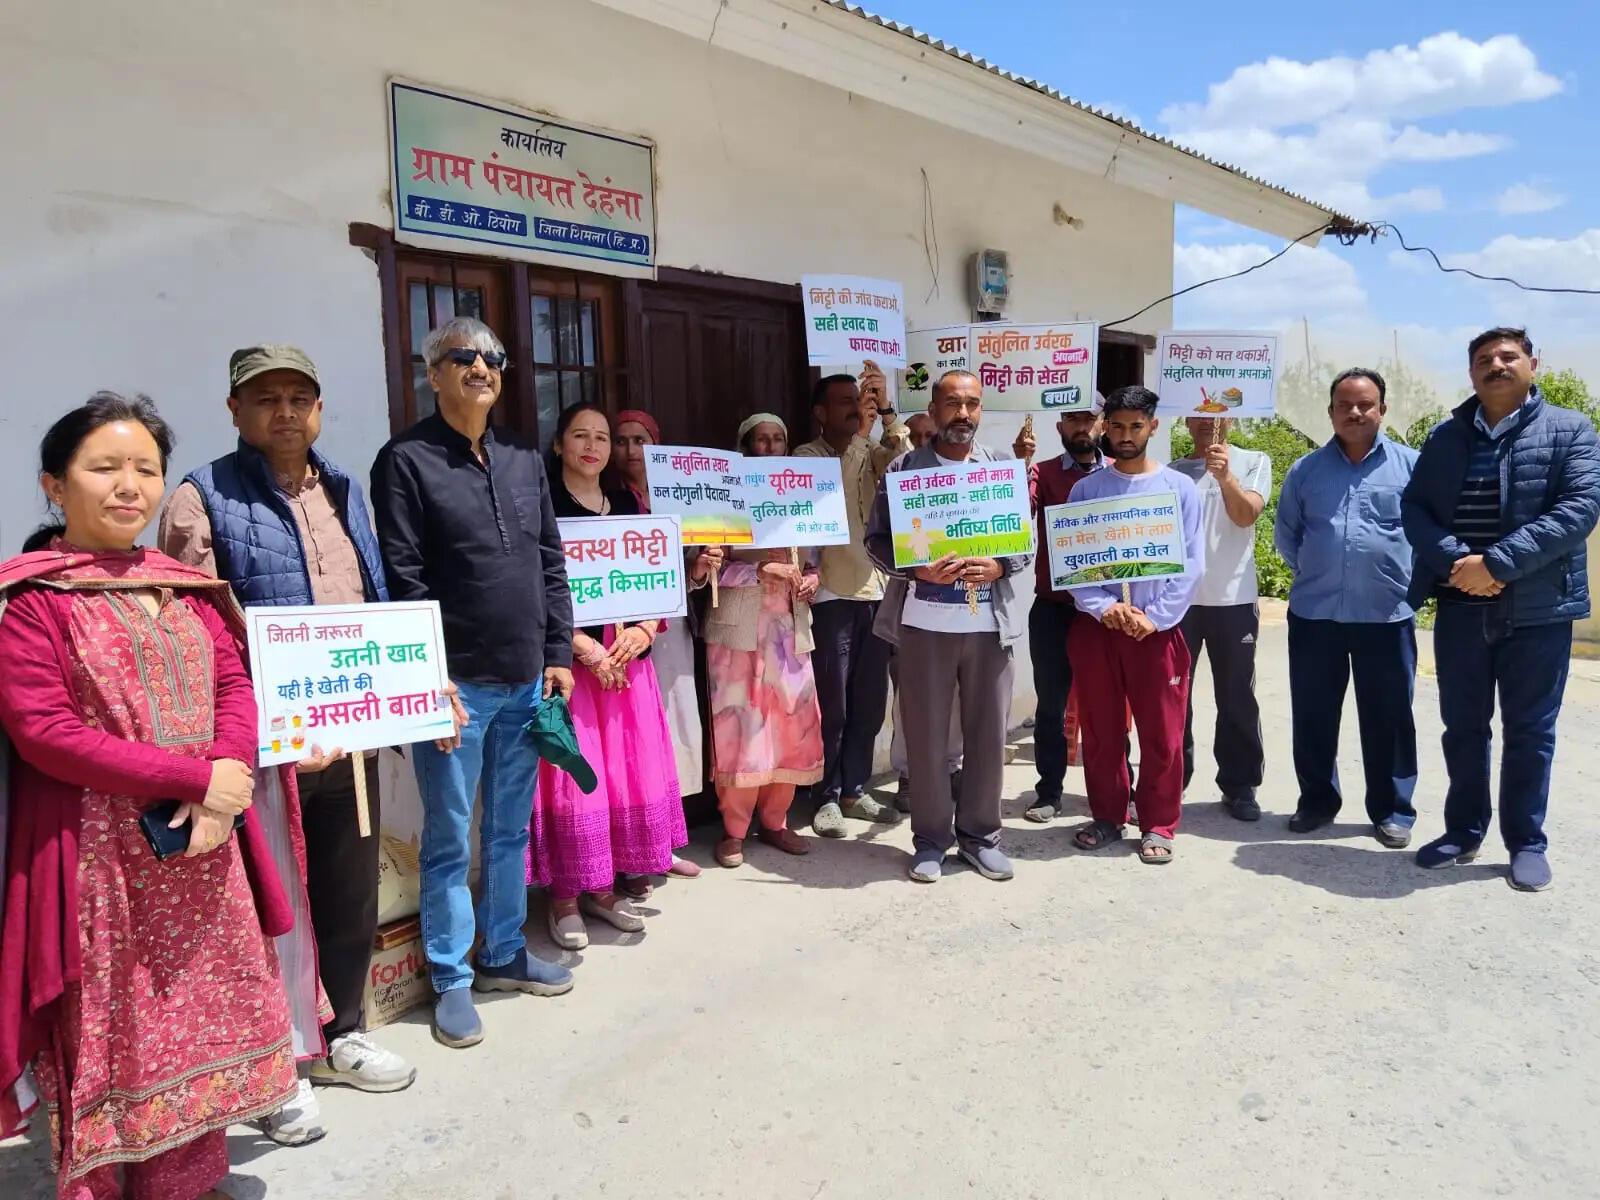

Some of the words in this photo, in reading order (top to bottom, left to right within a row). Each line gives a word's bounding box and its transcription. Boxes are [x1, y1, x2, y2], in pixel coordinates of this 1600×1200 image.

[501, 127, 567, 160] कार्यालय
[411, 147, 475, 190] ग्राम
[483, 152, 576, 210] पंचायत
[414, 203, 433, 219] बी.
[439, 203, 456, 223] डी.
[462, 208, 482, 227] ओ.
[487, 210, 521, 233] ठियोग
[538, 219, 568, 238] जिला
[809, 288, 835, 309] मिट्टी
[837, 288, 853, 304] की
[854, 289, 872, 306] जांच
[873, 294, 900, 312] कराओ,
[814, 313, 838, 331] सही
[840, 317, 865, 331] खाद
[866, 318, 878, 332] का
[849, 338, 879, 352] फायदा
[880, 339, 901, 356] पाओ!
[978, 331, 1029, 358] संतुलित
[1033, 330, 1073, 350] उर्वरक
[1169, 344, 1193, 363] मिट्टी
[1196, 346, 1213, 361] को
[1216, 350, 1233, 361] मत
[1236, 345, 1270, 364] थकाओ,
[936, 360, 947, 368] का
[950, 357, 966, 368] सही
[1163, 365, 1203, 382] संतुलित
[1207, 365, 1235, 379] पोषण
[1238, 366, 1272, 380] अपनाओ
[979, 362, 1012, 392] मिट्टी
[1015, 366, 1033, 386] की
[1037, 366, 1069, 386] सेहत
[651, 453, 667, 464] आज
[671, 452, 710, 475] संतुलित
[711, 458, 729, 473] खाद
[768, 469, 812, 495] यूरिया
[899, 475, 921, 492] सही
[924, 473, 956, 489] उर्वरक
[966, 468, 988, 484] सही
[990, 468, 1015, 482] मात्रा
[653, 486, 670, 498] कल
[671, 482, 703, 505] दोगुनी
[704, 483, 731, 502] पैदावार
[903, 494, 925, 510] सही
[928, 493, 958, 508] समय
[968, 486, 990, 502] सही
[992, 484, 1014, 499] विधि
[749, 501, 787, 522] तुलित
[789, 500, 813, 517] खेती
[1053, 517, 1080, 530] जैविक
[1082, 513, 1101, 526] और
[1102, 508, 1150, 523] रासायनिक
[1152, 506, 1174, 516] खाद
[946, 518, 988, 538] भविष्य
[990, 513, 1021, 534] निधि
[1056, 536, 1072, 548] का
[1104, 525, 1131, 541] खेती
[622, 528, 668, 565] मिट्टी
[1064, 547, 1117, 570] खुशहाली
[1122, 547, 1139, 559] का
[1143, 542, 1168, 556] खेल
[568, 577, 603, 603] मृद्ध
[608, 569, 676, 594] किसान!
[267, 622, 310, 644] जितनी
[314, 624, 363, 641] जरूरत
[329, 640, 380, 669] उतनी
[386, 642, 427, 664] खाद
[277, 680, 300, 700] यही
[304, 677, 314, 699] है
[317, 675, 349, 695] खेती
[354, 673, 373, 691] की
[307, 691, 381, 728] असली
[387, 689, 438, 717] बात!
